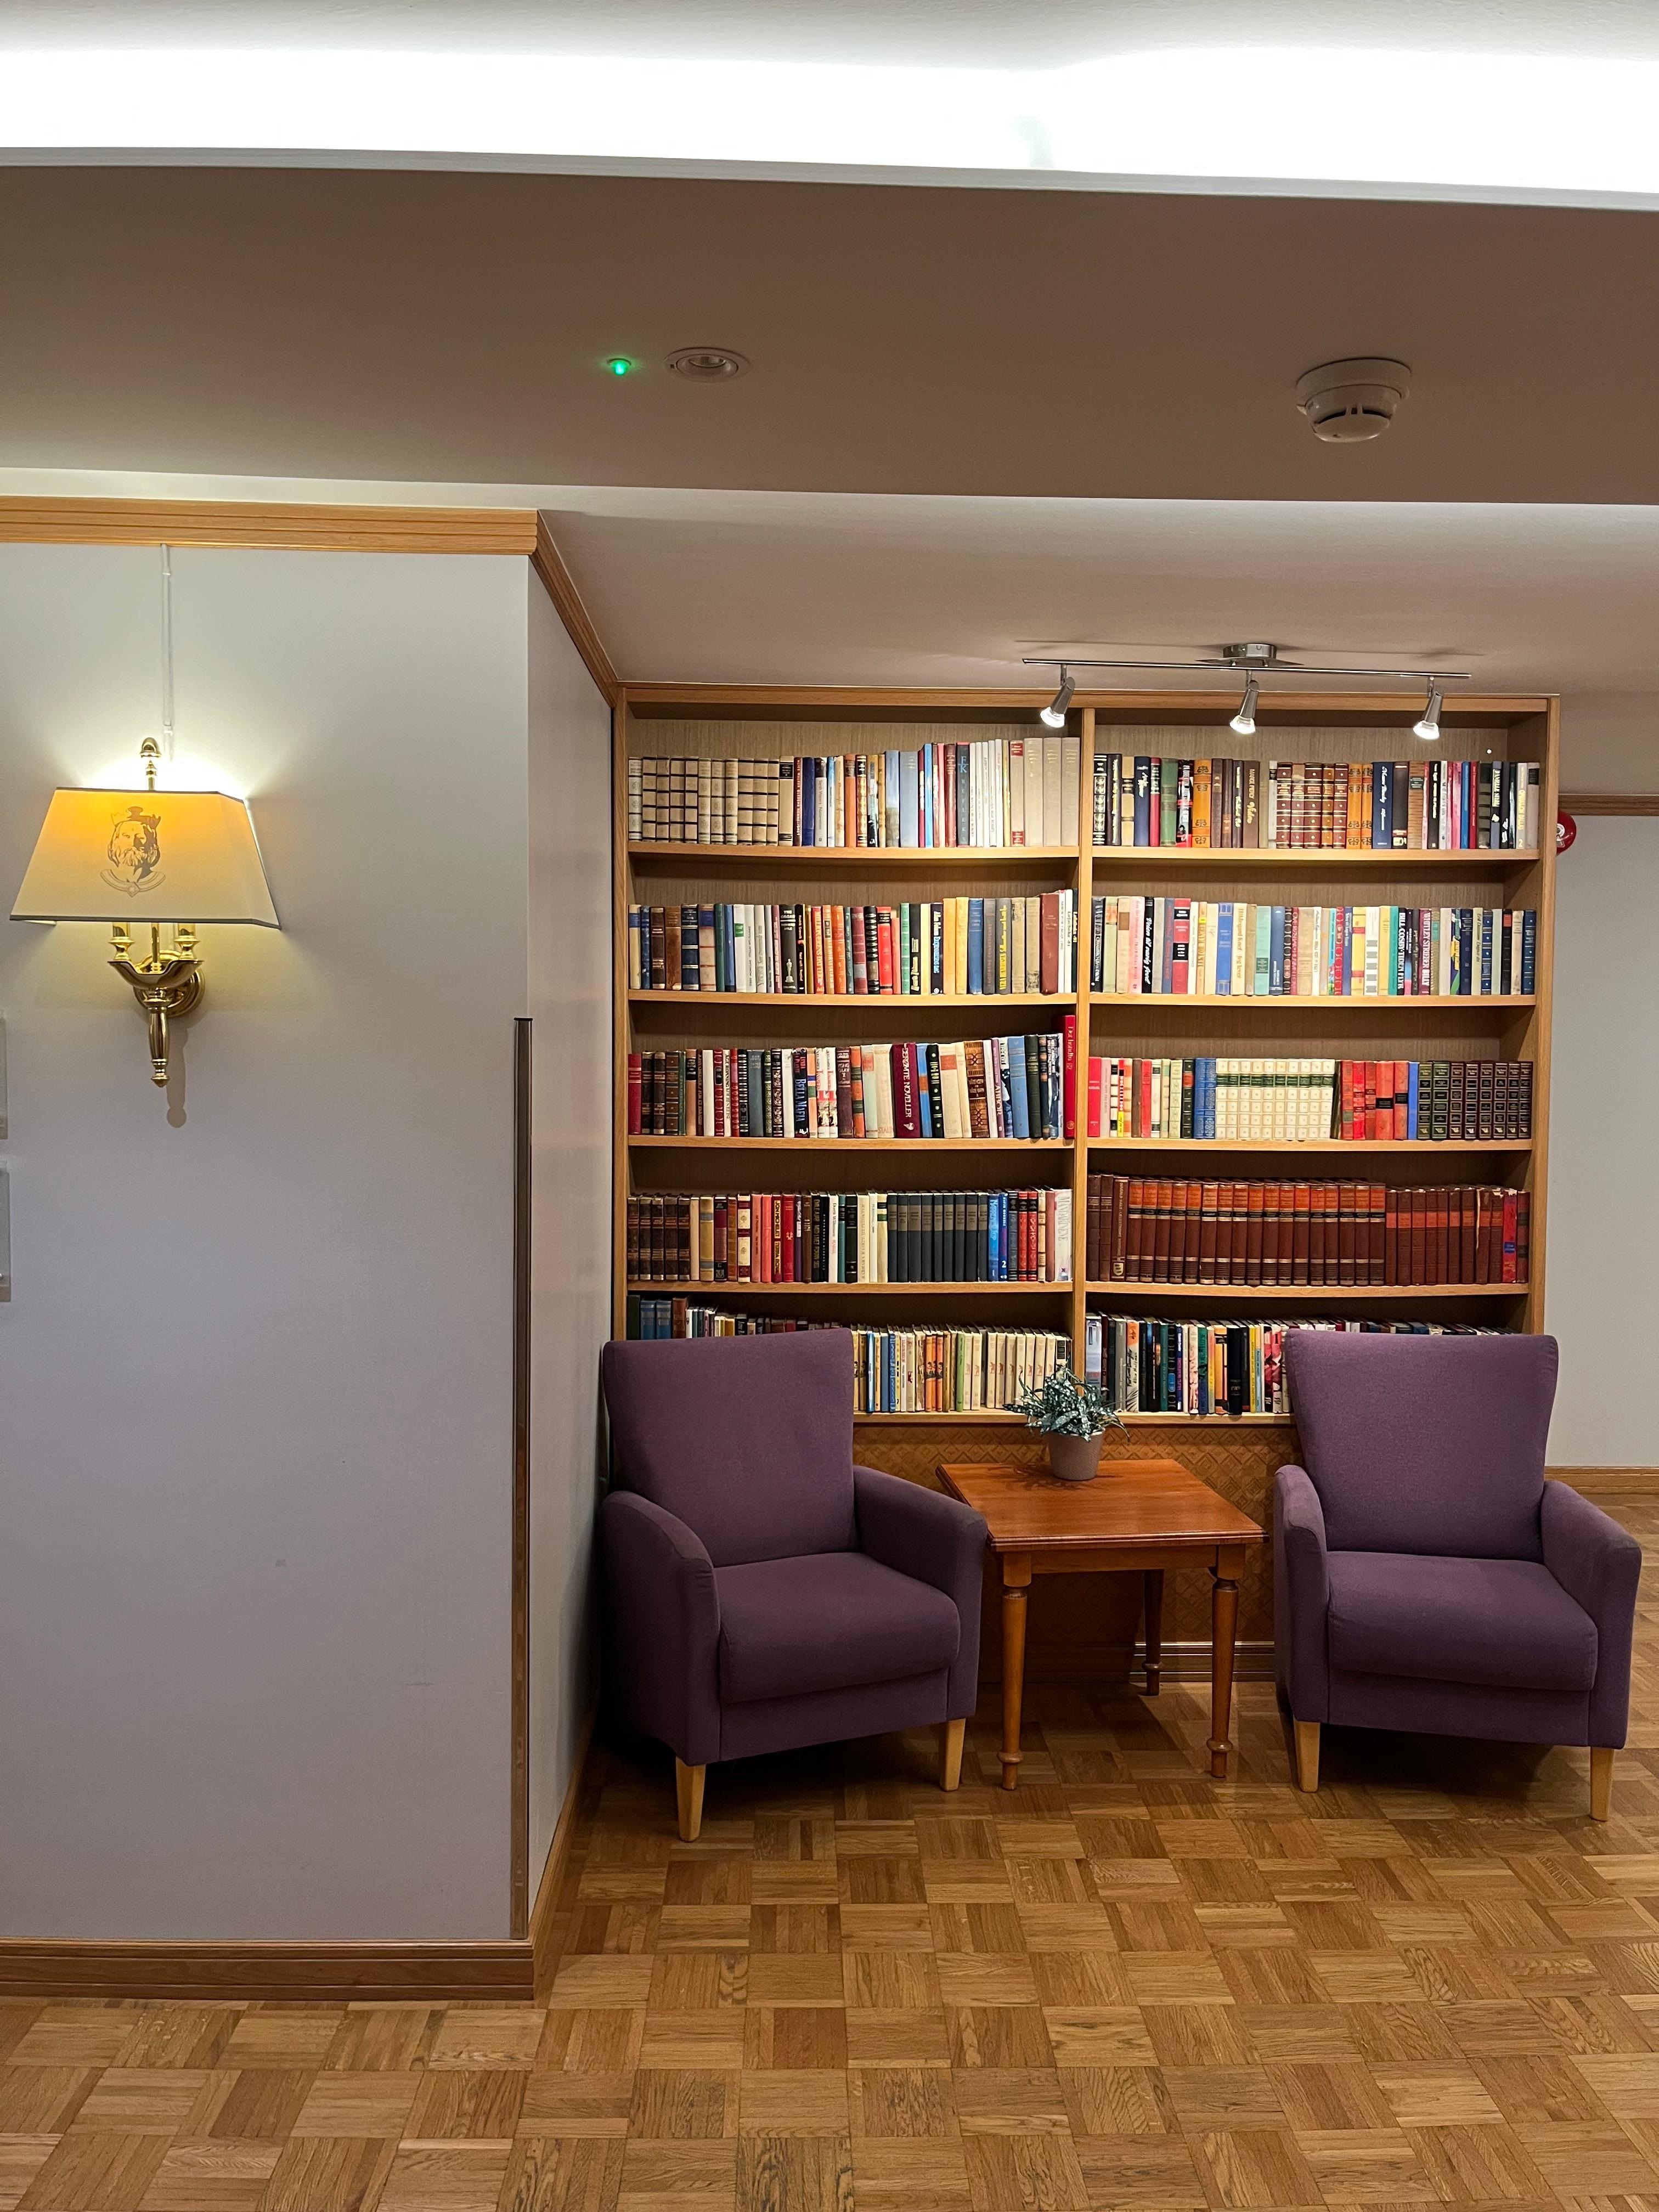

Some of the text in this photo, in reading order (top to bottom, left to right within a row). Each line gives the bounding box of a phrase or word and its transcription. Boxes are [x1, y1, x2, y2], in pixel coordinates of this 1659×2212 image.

[1422, 940, 1430, 968] STRIEBER
[1421, 969, 1430, 986] BILLY
[795, 1079, 807, 1122] BELLA MAFIA
[904, 1081, 912, 1117] NOVELLER
